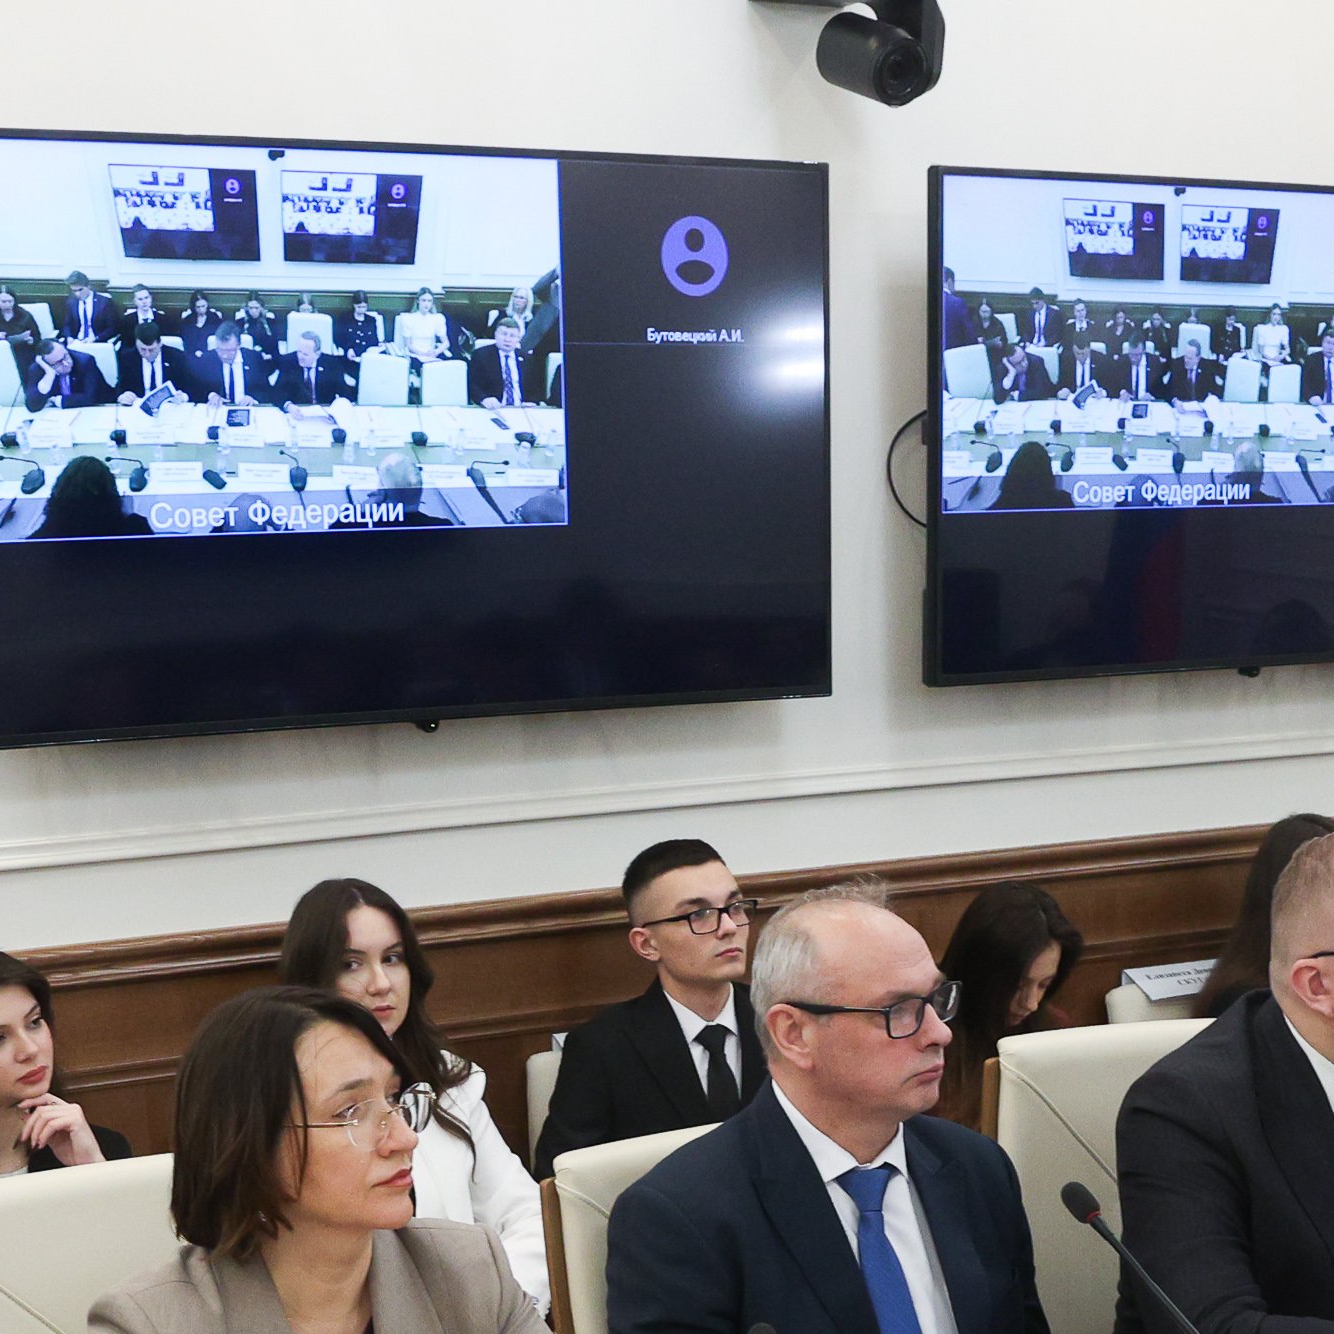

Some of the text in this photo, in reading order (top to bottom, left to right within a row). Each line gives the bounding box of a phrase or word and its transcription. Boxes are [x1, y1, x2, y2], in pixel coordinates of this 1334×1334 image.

[1073, 480, 1250, 505] Совет Федерации
[150, 500, 404, 529] Совет Федерации
